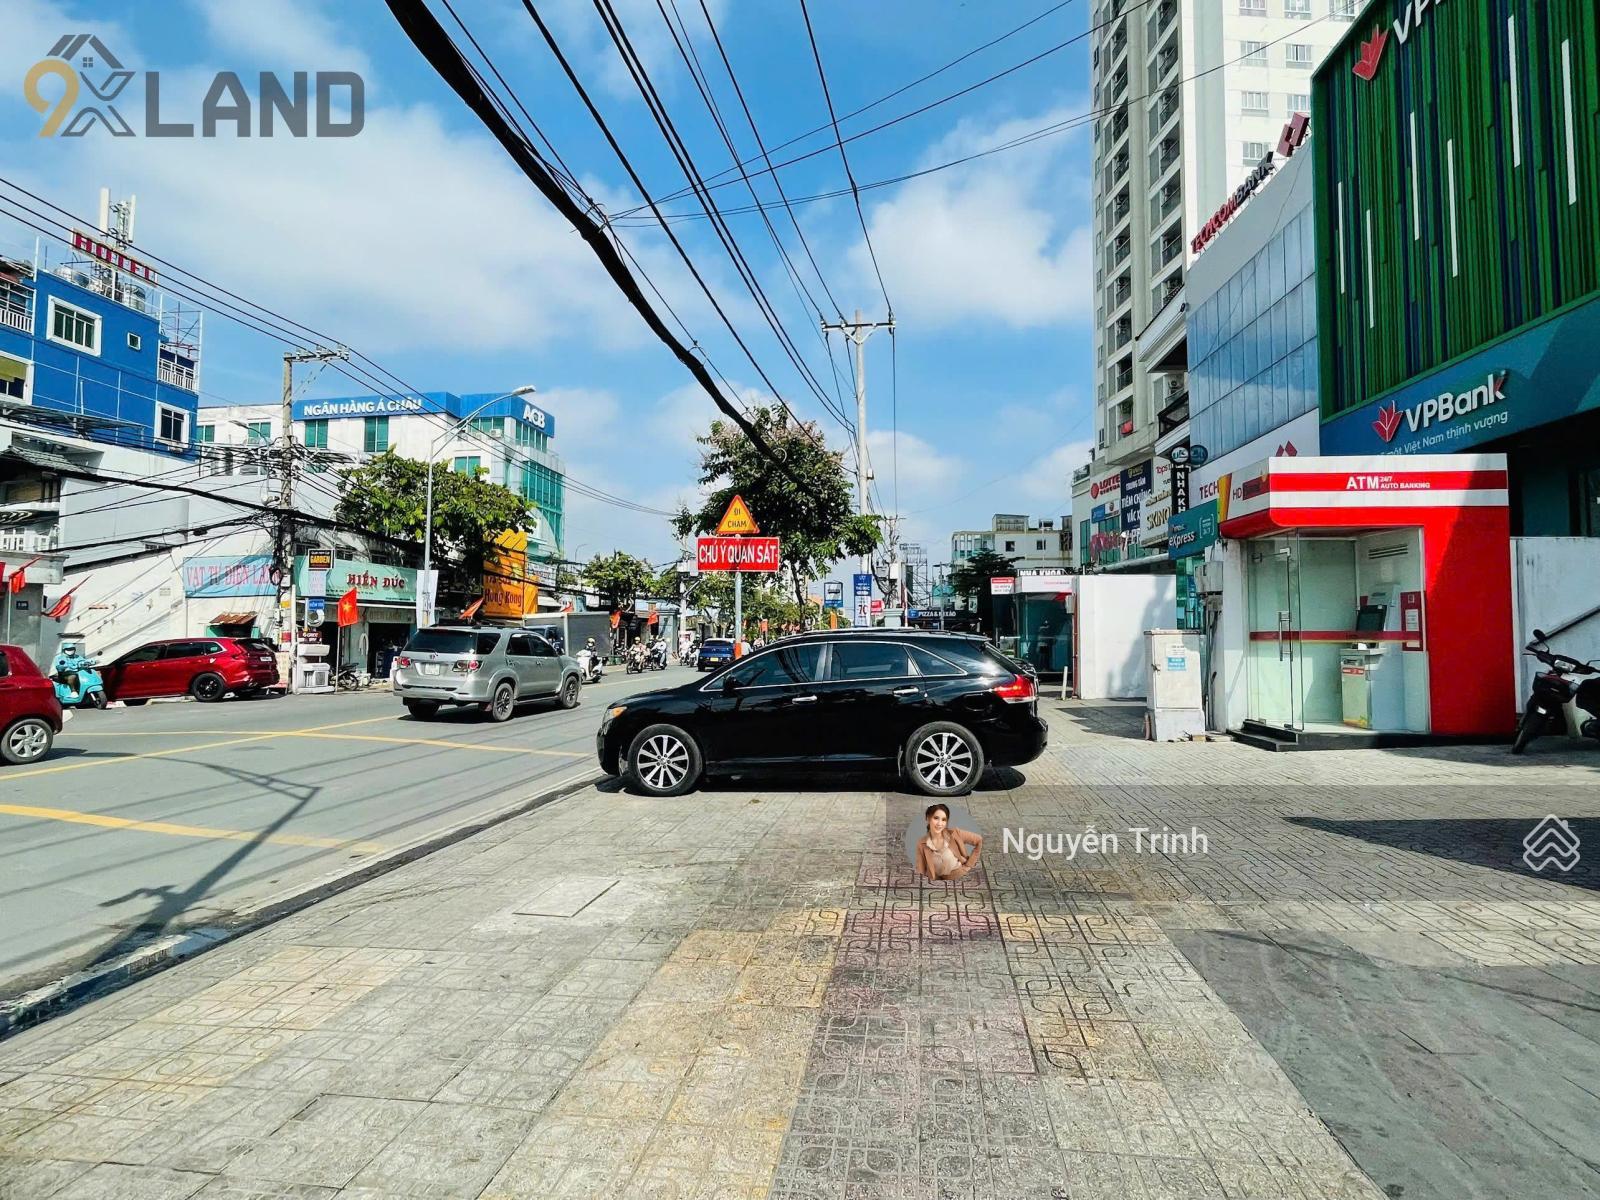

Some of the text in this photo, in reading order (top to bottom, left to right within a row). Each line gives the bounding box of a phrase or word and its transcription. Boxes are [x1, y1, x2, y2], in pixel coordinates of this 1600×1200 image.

[303, 402, 338, 416] NGÂN
[340, 400, 375, 413] HÀNG
[376, 398, 386, 411] Á
[1405, 370, 1507, 433] VPBank
[523, 404, 546, 429] ACB
[1404, 439, 1421, 454] Việt
[1422, 433, 1444, 448] Nam
[1446, 424, 1471, 439] thịnh
[1473, 411, 1508, 429] vượng
[1099, 474, 1120, 489] LOTTE
[1346, 476, 1380, 490] ATM
[699, 540, 777, 563] CHÚ Ý QUAN SÁT
[383, 575, 405, 588] ĐỨC
